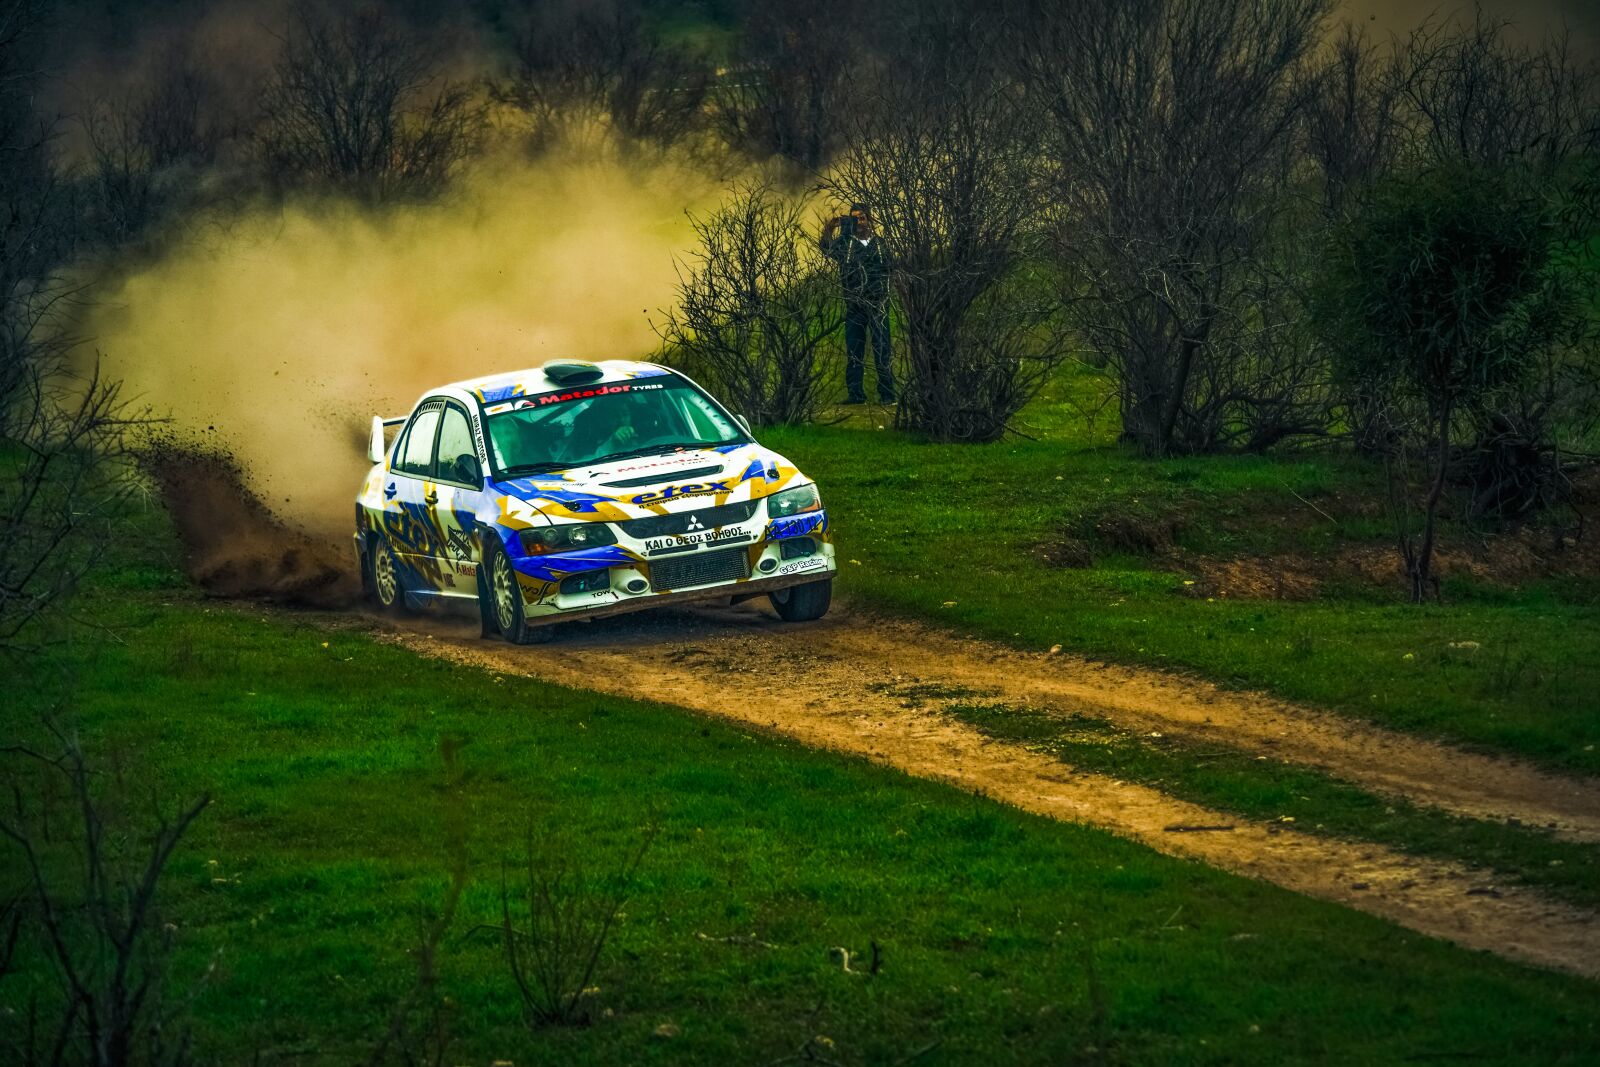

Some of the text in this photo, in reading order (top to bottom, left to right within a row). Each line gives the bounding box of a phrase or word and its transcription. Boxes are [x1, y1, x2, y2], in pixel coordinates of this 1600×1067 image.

[539, 384, 631, 405] Matador
[476, 436, 487, 465] MOTORS
[631, 480, 731, 505] etex
[645, 539, 664, 551] ΚΑΙ
[676, 534, 703, 546] ΘΕΟΣ
[592, 589, 611, 599] TOW
